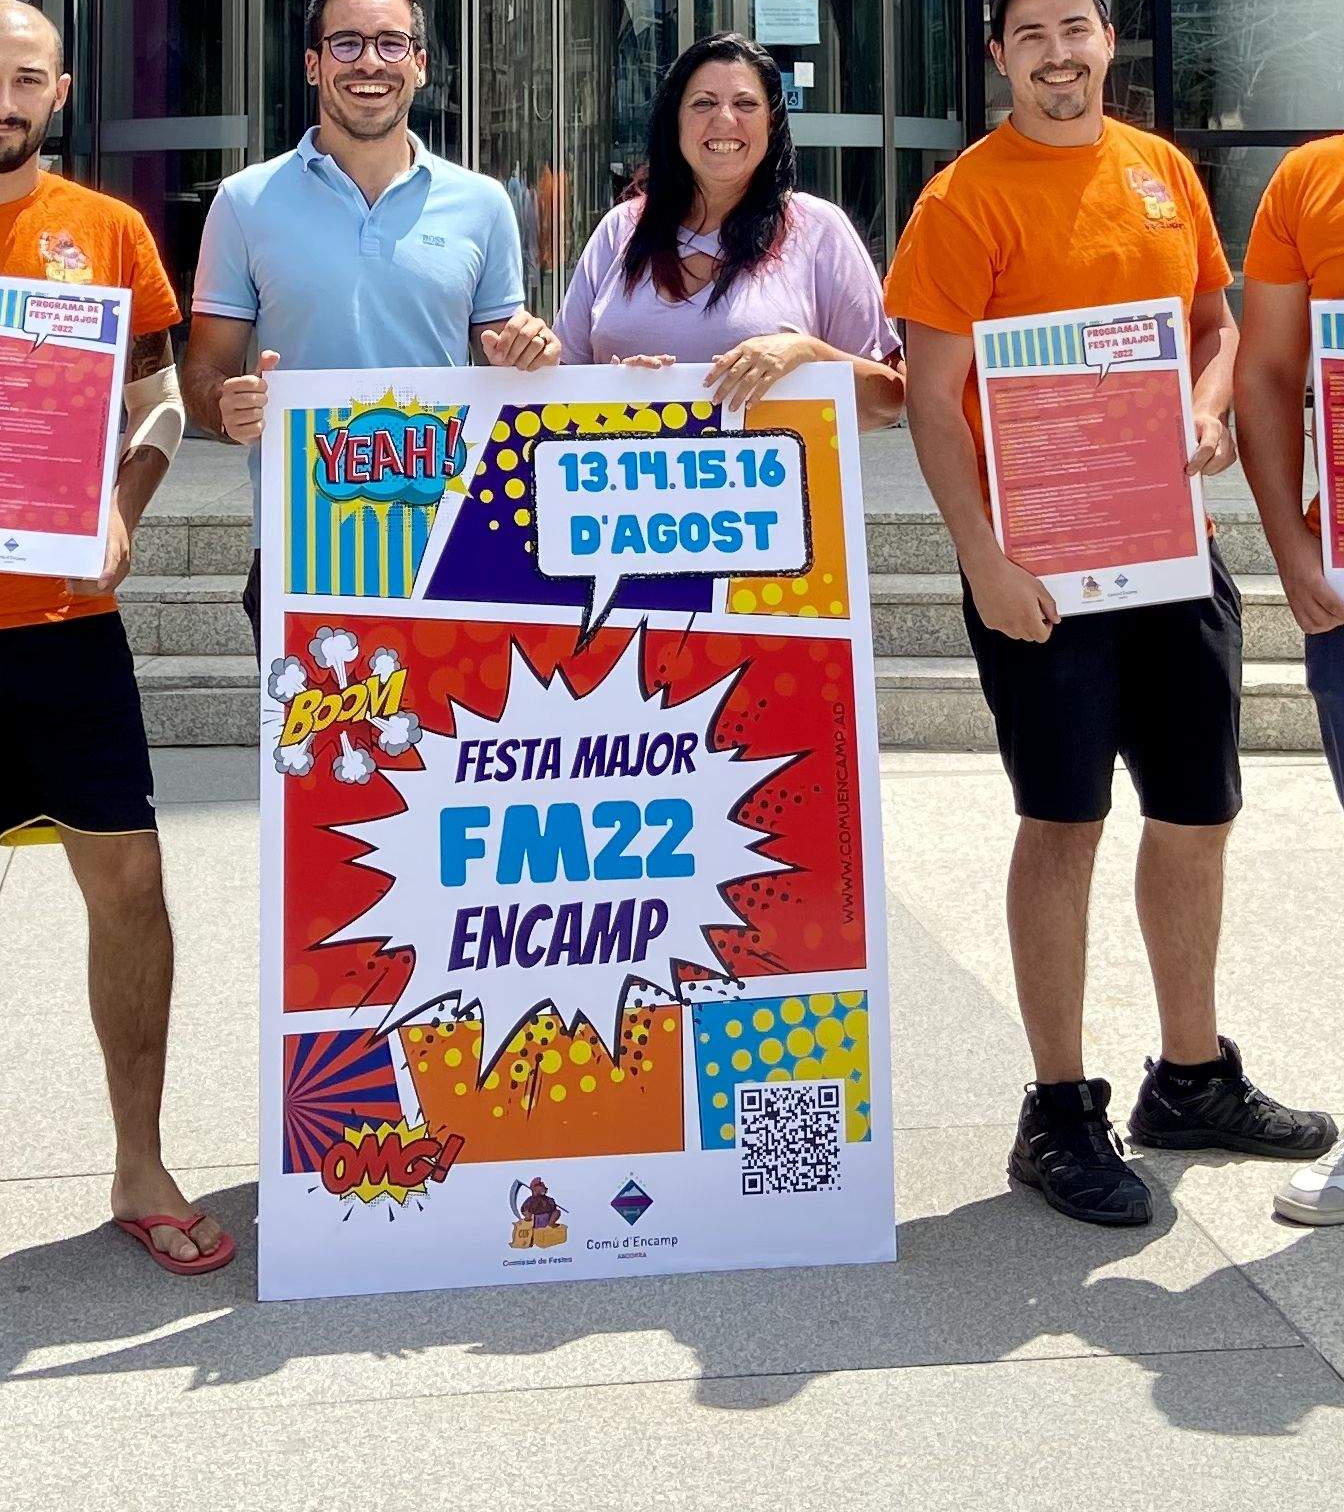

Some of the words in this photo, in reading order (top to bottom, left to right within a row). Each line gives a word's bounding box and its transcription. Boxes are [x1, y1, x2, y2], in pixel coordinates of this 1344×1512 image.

[29, 310, 61, 321] FESTA
[30, 299, 85, 312] PROGRAMA
[1087, 324, 1140, 337] PROGRAMA
[1088, 339, 1119, 349] FESTA
[1122, 335, 1156, 345] MAJOR
[314, 416, 462, 484] YEAH!
[558, 449, 786, 493] 13.14.15.16
[570, 510, 779, 556] D'AGOST
[278, 668, 409, 748] BOOM
[455, 736, 562, 783] FESTA
[570, 731, 699, 780] MAJOR
[440, 798, 696, 887] FM22
[447, 898, 669, 973] ENCAMP
[321, 1131, 466, 1195] OMG!
[586, 1237, 620, 1250] Comú
[622, 1235, 679, 1249] d'Encamp
